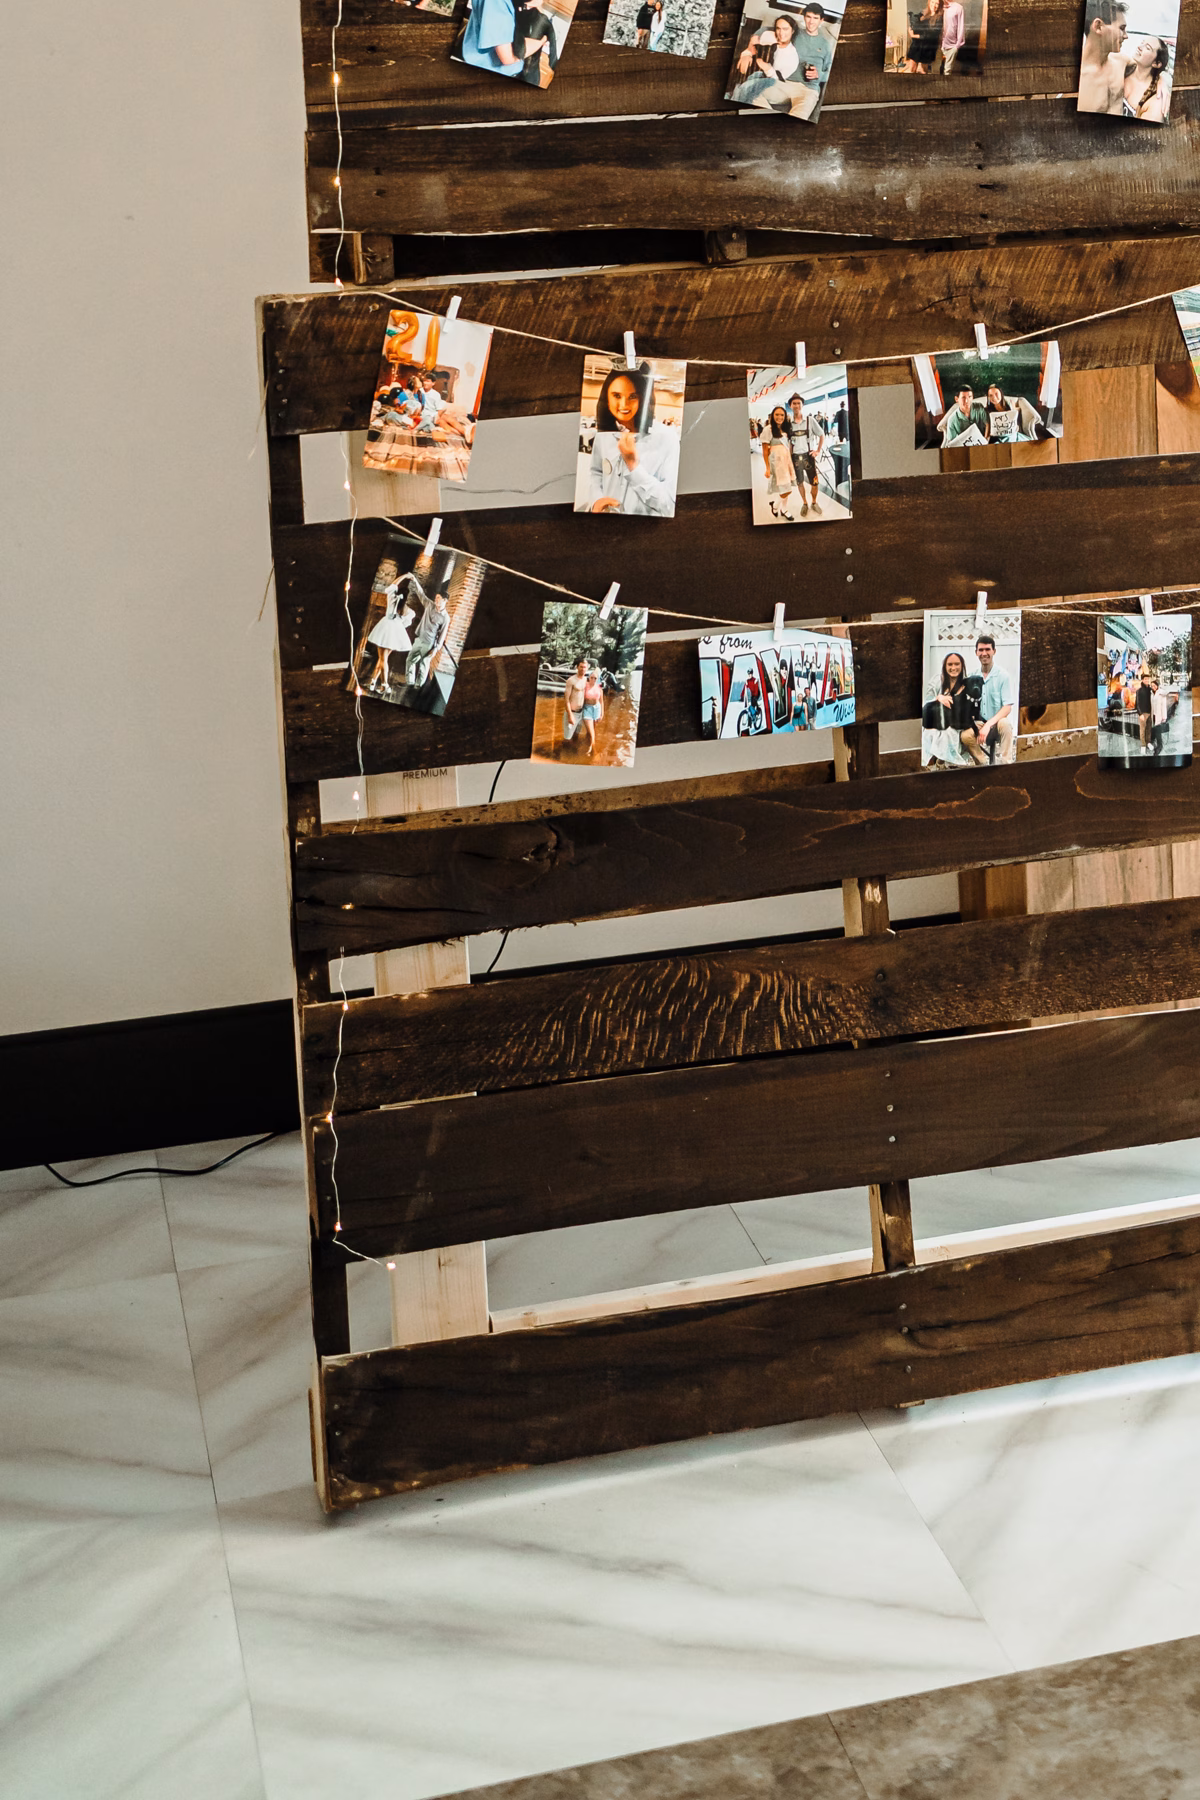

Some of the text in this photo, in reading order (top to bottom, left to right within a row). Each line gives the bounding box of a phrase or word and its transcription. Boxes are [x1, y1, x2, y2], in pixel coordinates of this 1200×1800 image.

[386, 310, 440, 371] 21
[720, 634, 752, 654] from
[402, 768, 448, 780] PREMIUM
